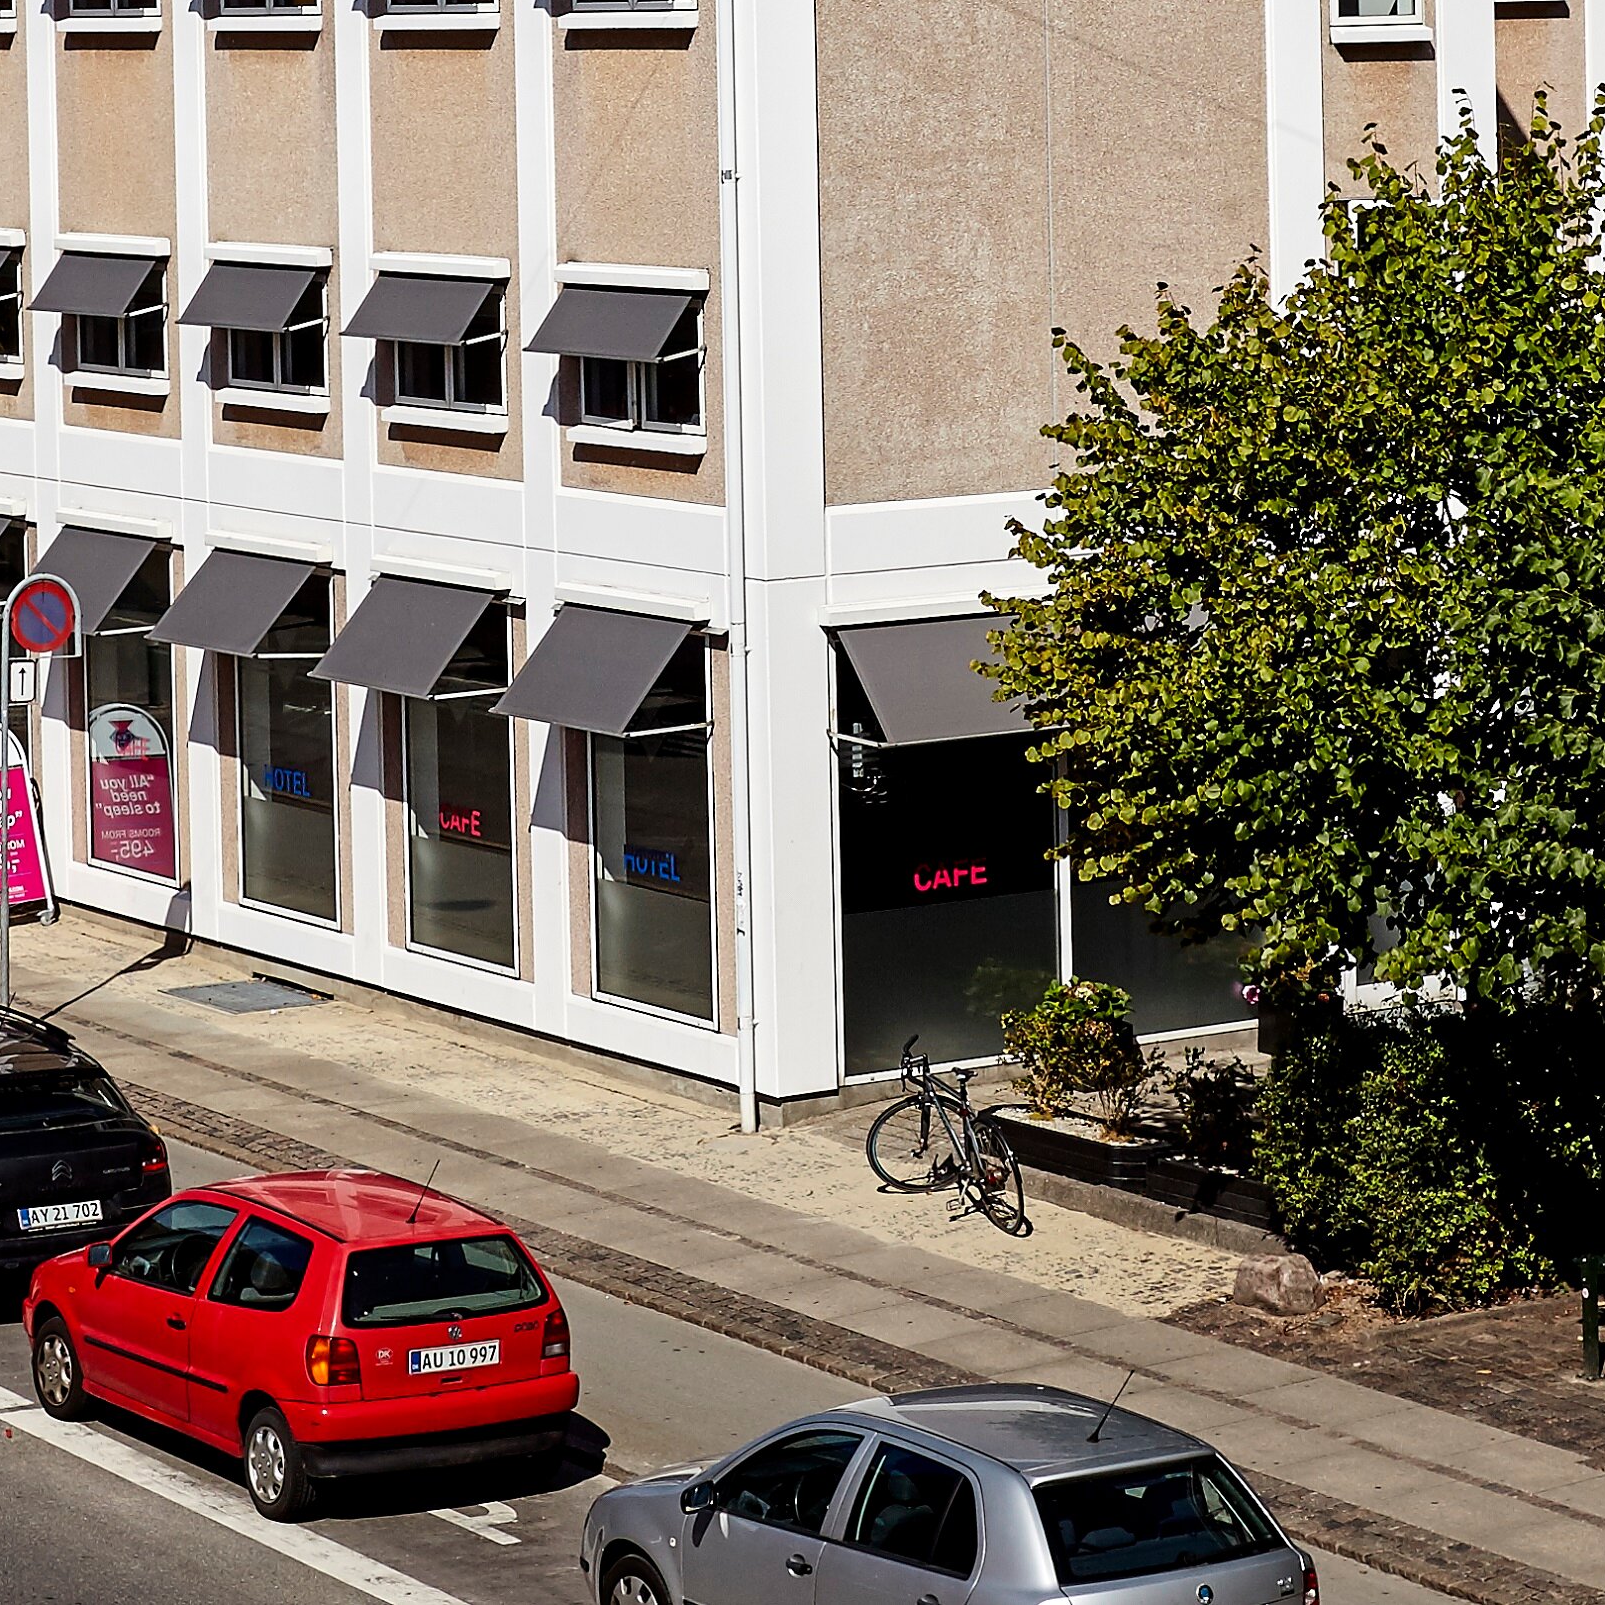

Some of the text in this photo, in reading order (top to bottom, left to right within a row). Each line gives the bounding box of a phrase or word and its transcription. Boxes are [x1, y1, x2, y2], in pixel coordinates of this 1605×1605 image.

[263, 764, 311, 798] HOTEL
[439, 804, 482, 838] CAFE
[624, 847, 681, 882] HOTEL
[912, 857, 987, 892] CAFE
[31, 1202, 100, 1224] AY 21 702
[423, 1344, 497, 1369] AU 10 997
